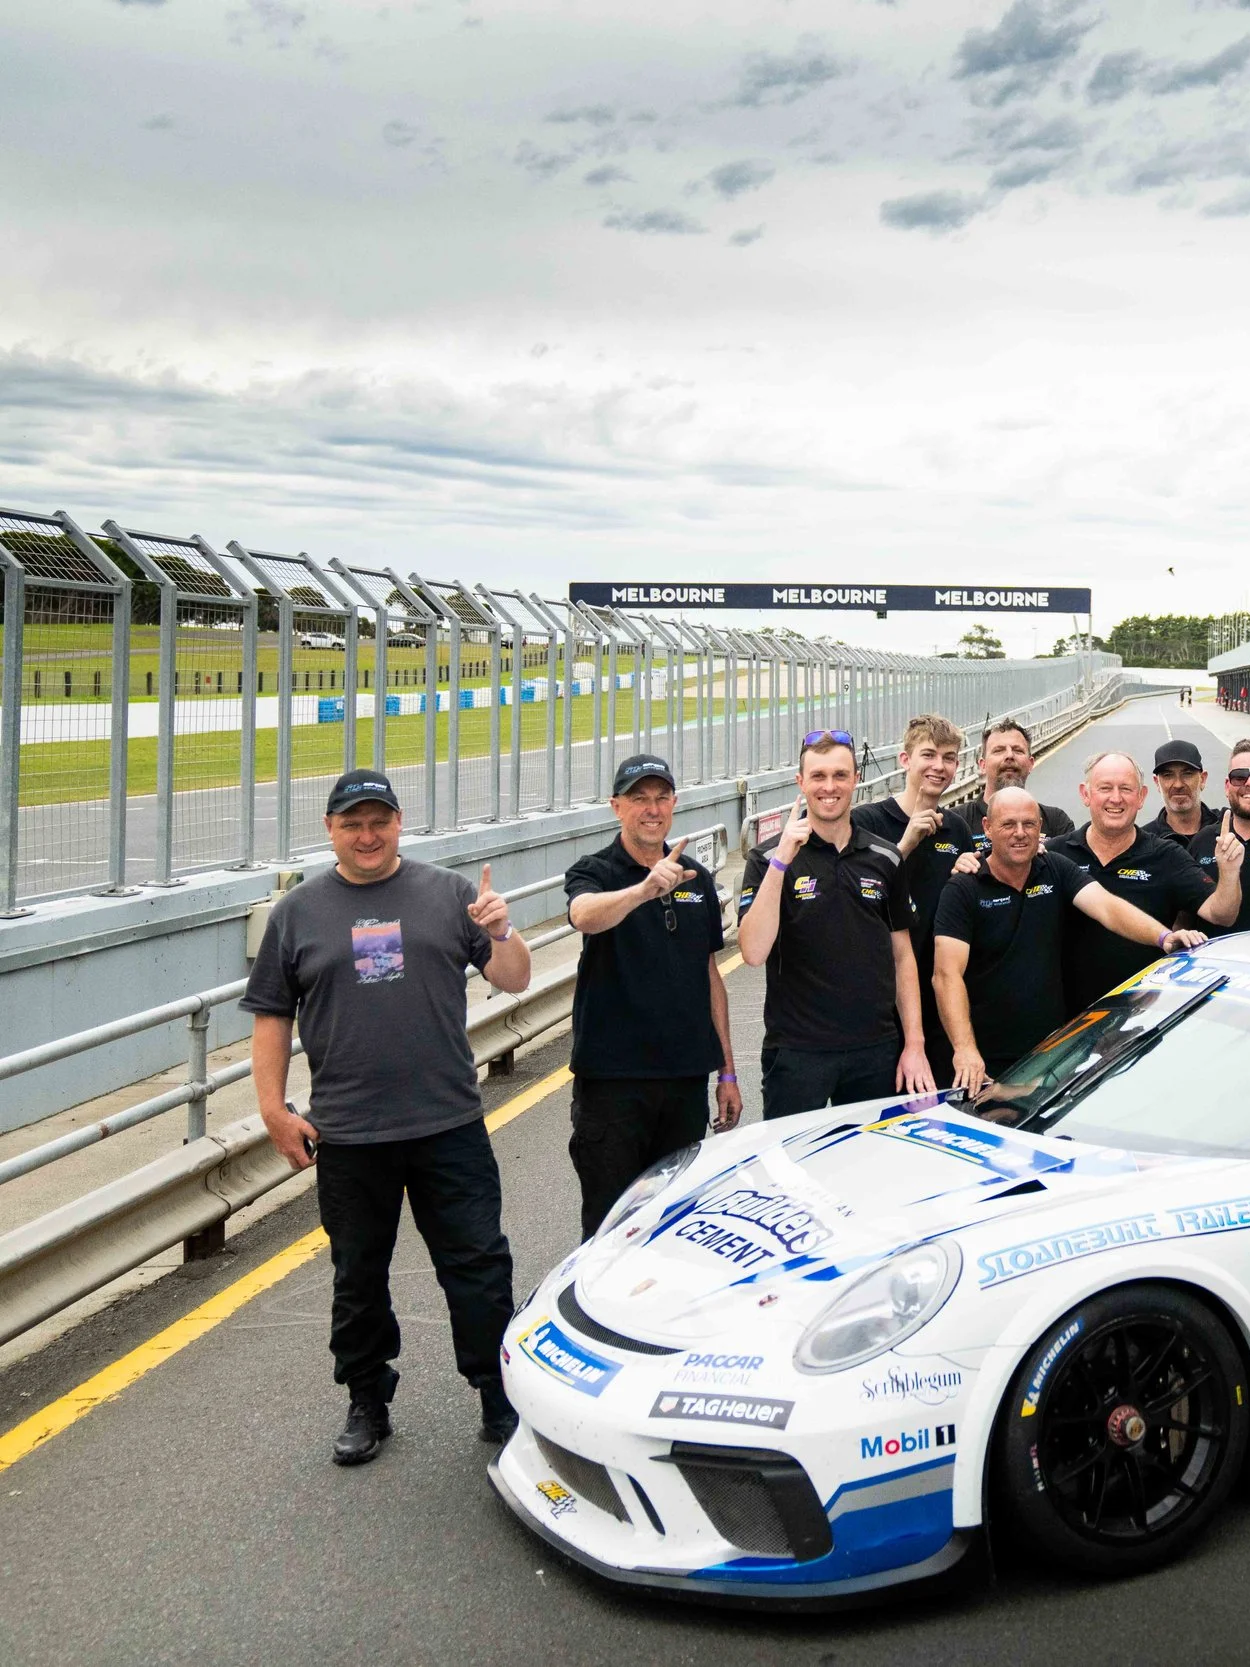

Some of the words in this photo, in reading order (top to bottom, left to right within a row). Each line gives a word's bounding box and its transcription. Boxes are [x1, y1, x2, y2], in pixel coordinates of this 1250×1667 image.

[611, 587, 725, 603] MELBOURNE
[772, 588, 887, 604] MELBOURNE
[935, 590, 1050, 607] MELBOURNE
[706, 1190, 834, 1255] Builders
[675, 1220, 775, 1269] CEMENT
[540, 1337, 607, 1384] MICHELIN
[682, 1352, 765, 1371] PACCAR
[1032, 1321, 1080, 1389] MICHELIN
[673, 1370, 752, 1386] FINANCIAL
[860, 1428, 930, 1459] Mobil
